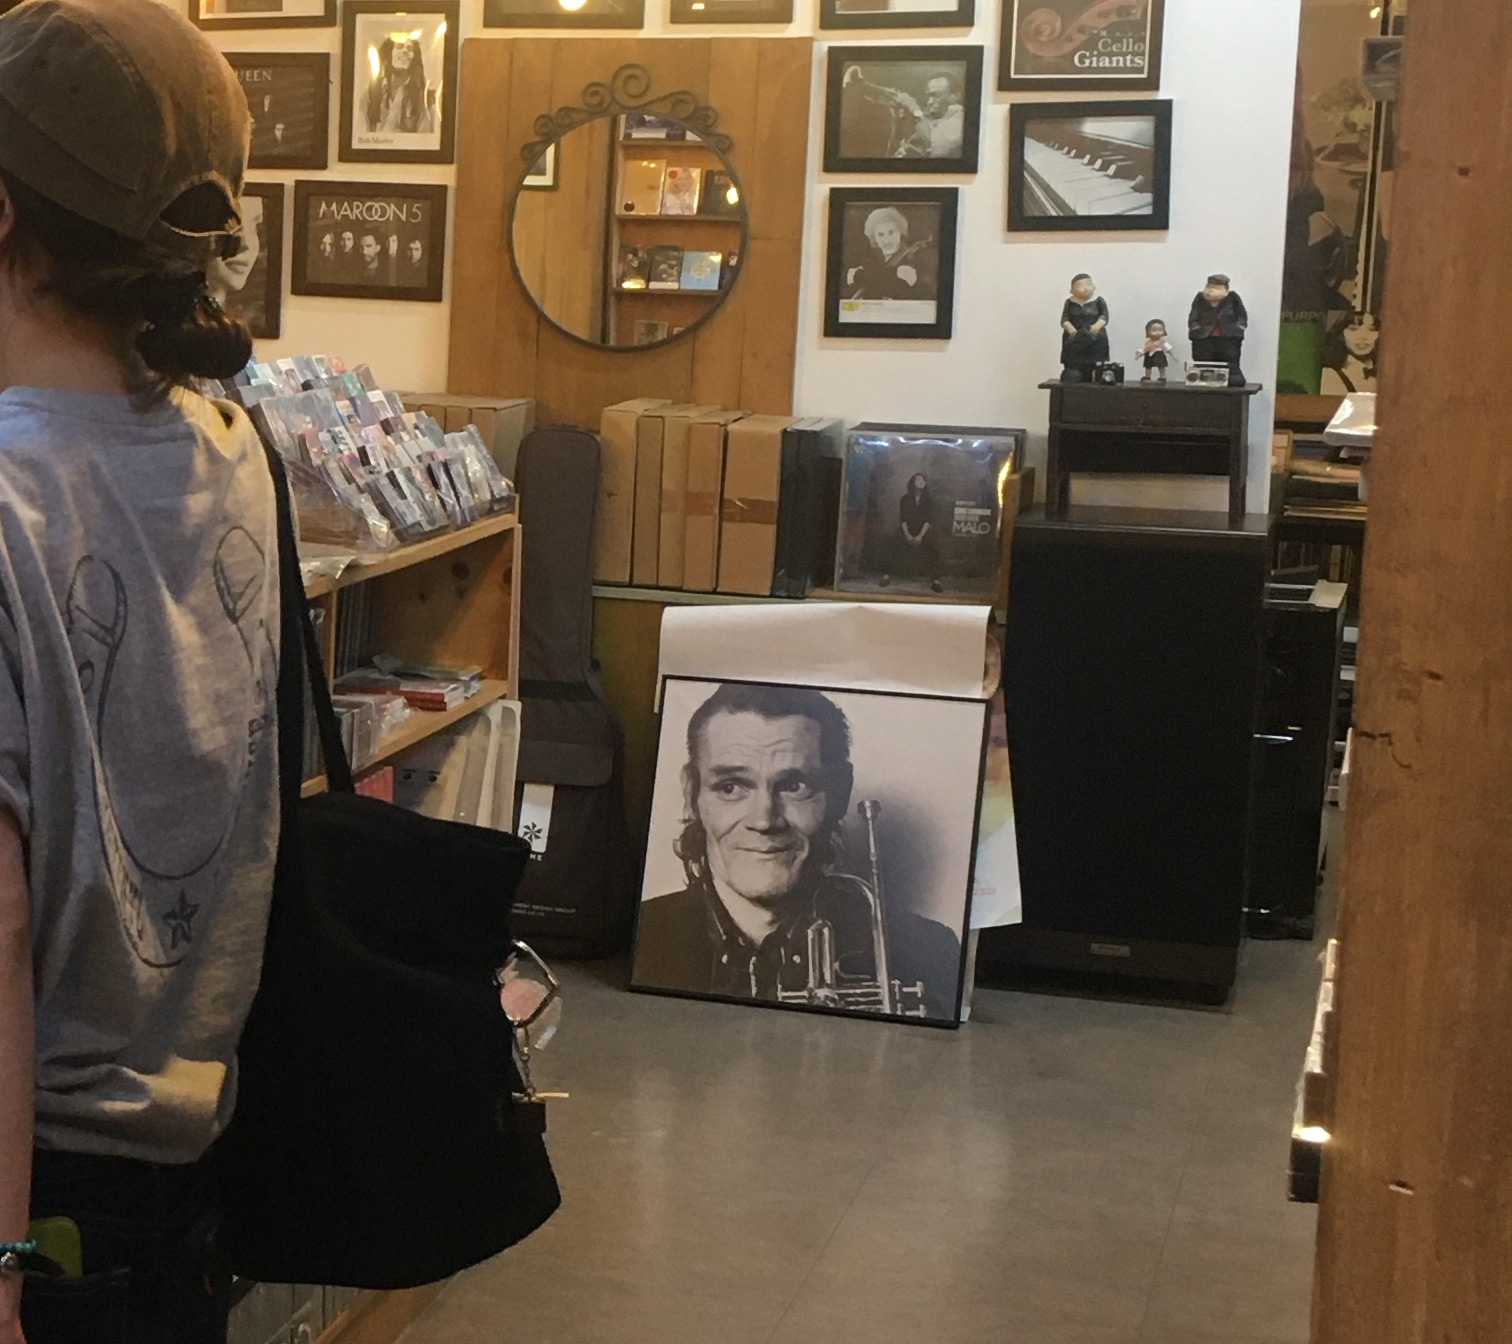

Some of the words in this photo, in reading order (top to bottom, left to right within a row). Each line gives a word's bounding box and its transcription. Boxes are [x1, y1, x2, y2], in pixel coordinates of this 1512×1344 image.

[1098, 38, 1145, 53] Cello
[1073, 50, 1145, 68] Giants
[235, 69, 273, 82] UEEN
[319, 200, 407, 222] MAROON
[409, 203, 422, 223] 5
